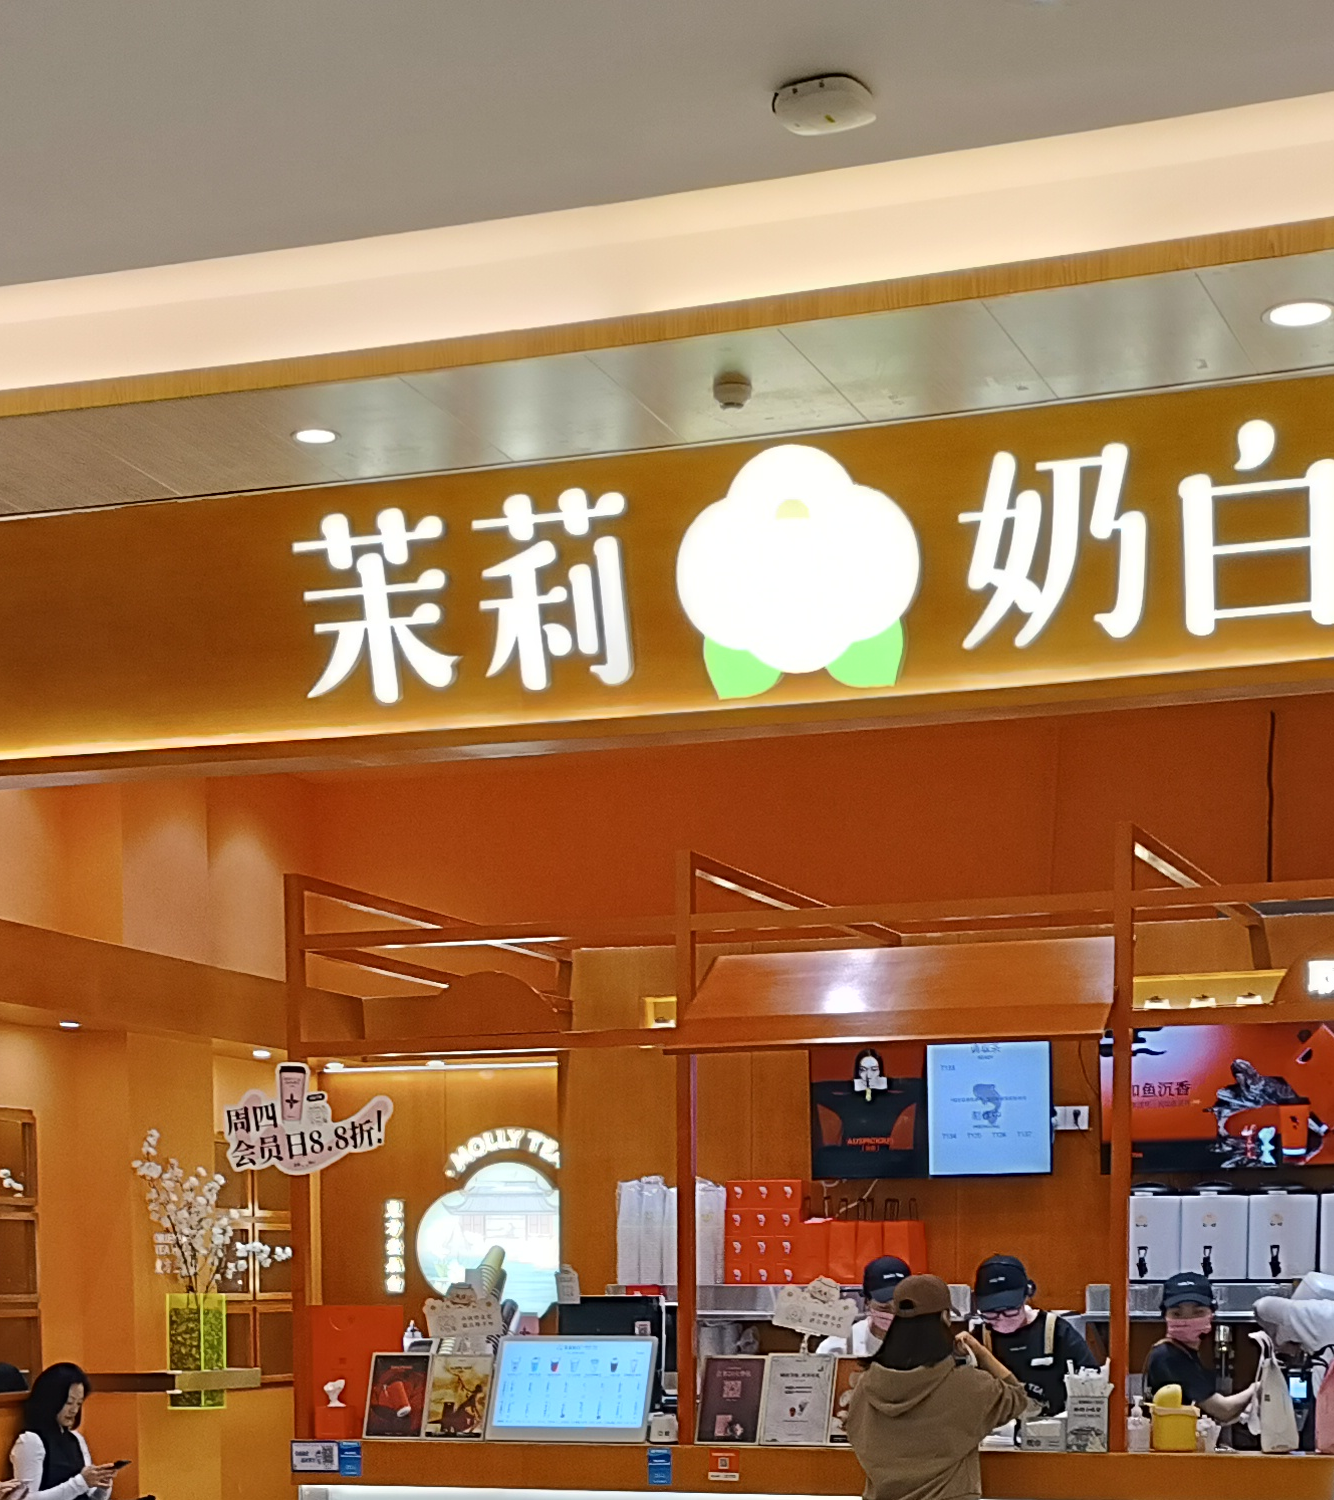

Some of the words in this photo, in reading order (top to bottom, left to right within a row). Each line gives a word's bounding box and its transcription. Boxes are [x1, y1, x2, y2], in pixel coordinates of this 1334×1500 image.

[292, 486, 637, 706] 茉莉
[226, 1102, 279, 1136] 周四
[232, 1109, 383, 1168] 会员日8.8折!
[449, 1128, 526, 1173] MOLLY
